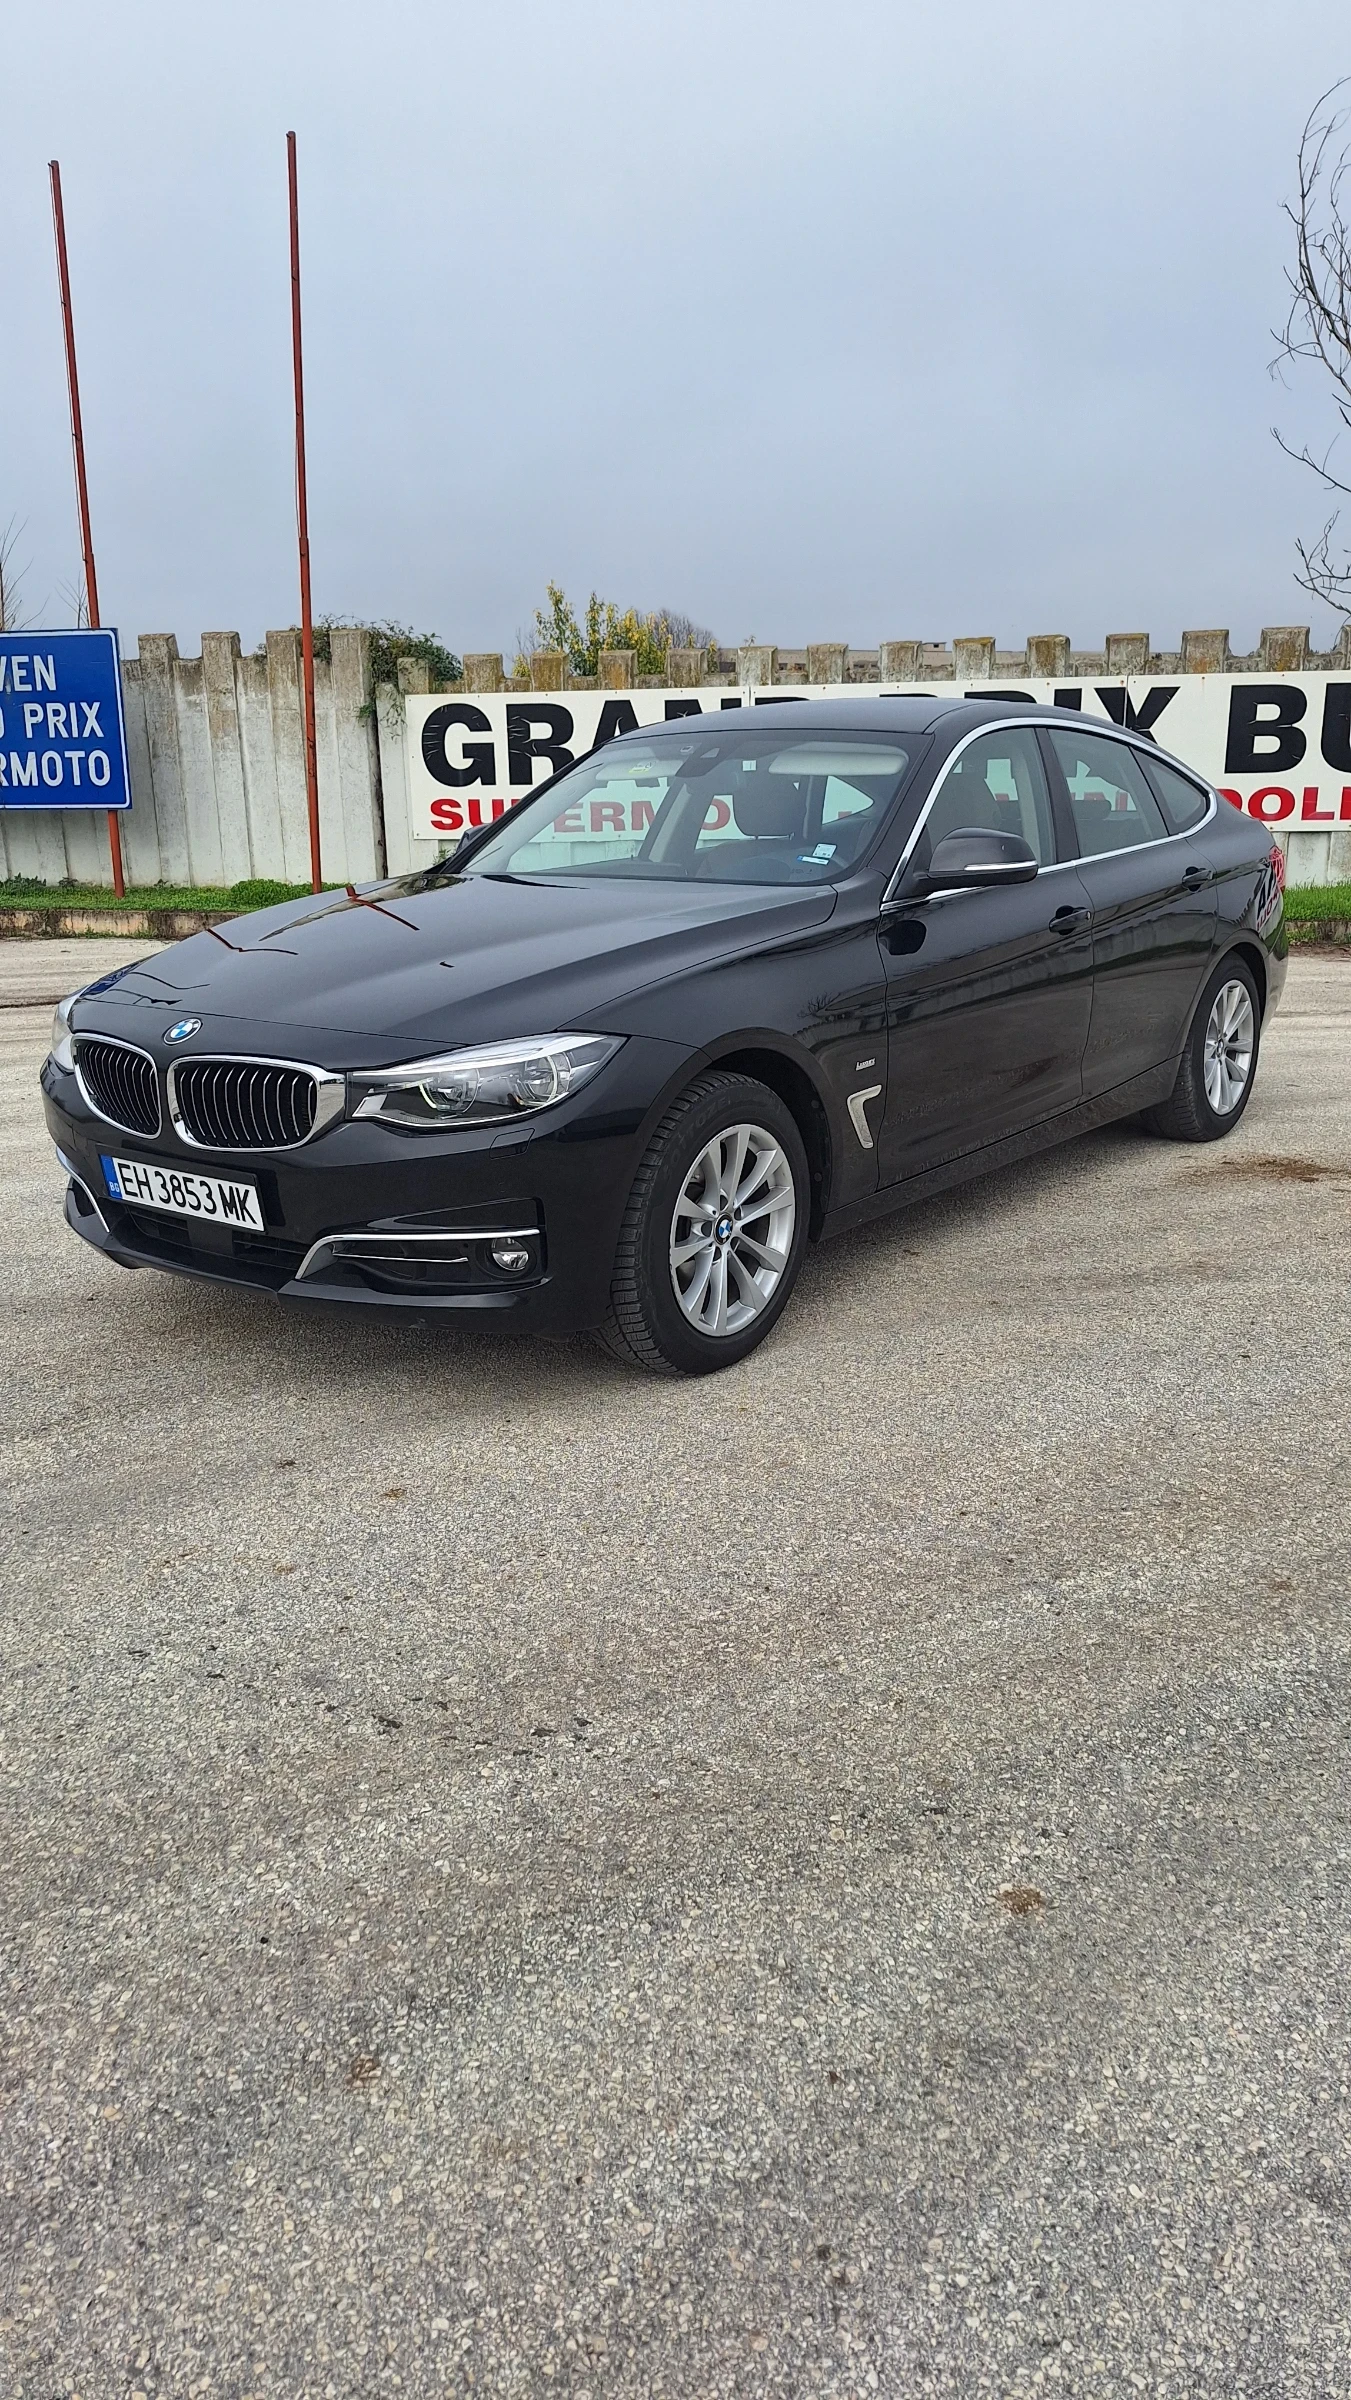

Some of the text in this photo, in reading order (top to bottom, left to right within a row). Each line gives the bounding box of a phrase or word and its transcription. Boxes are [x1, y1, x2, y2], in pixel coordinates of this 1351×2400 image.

[23, 702, 104, 739] PRIX
[109, 1181, 120, 1193] BG
[117, 1163, 258, 1225] EH 3853 MK
